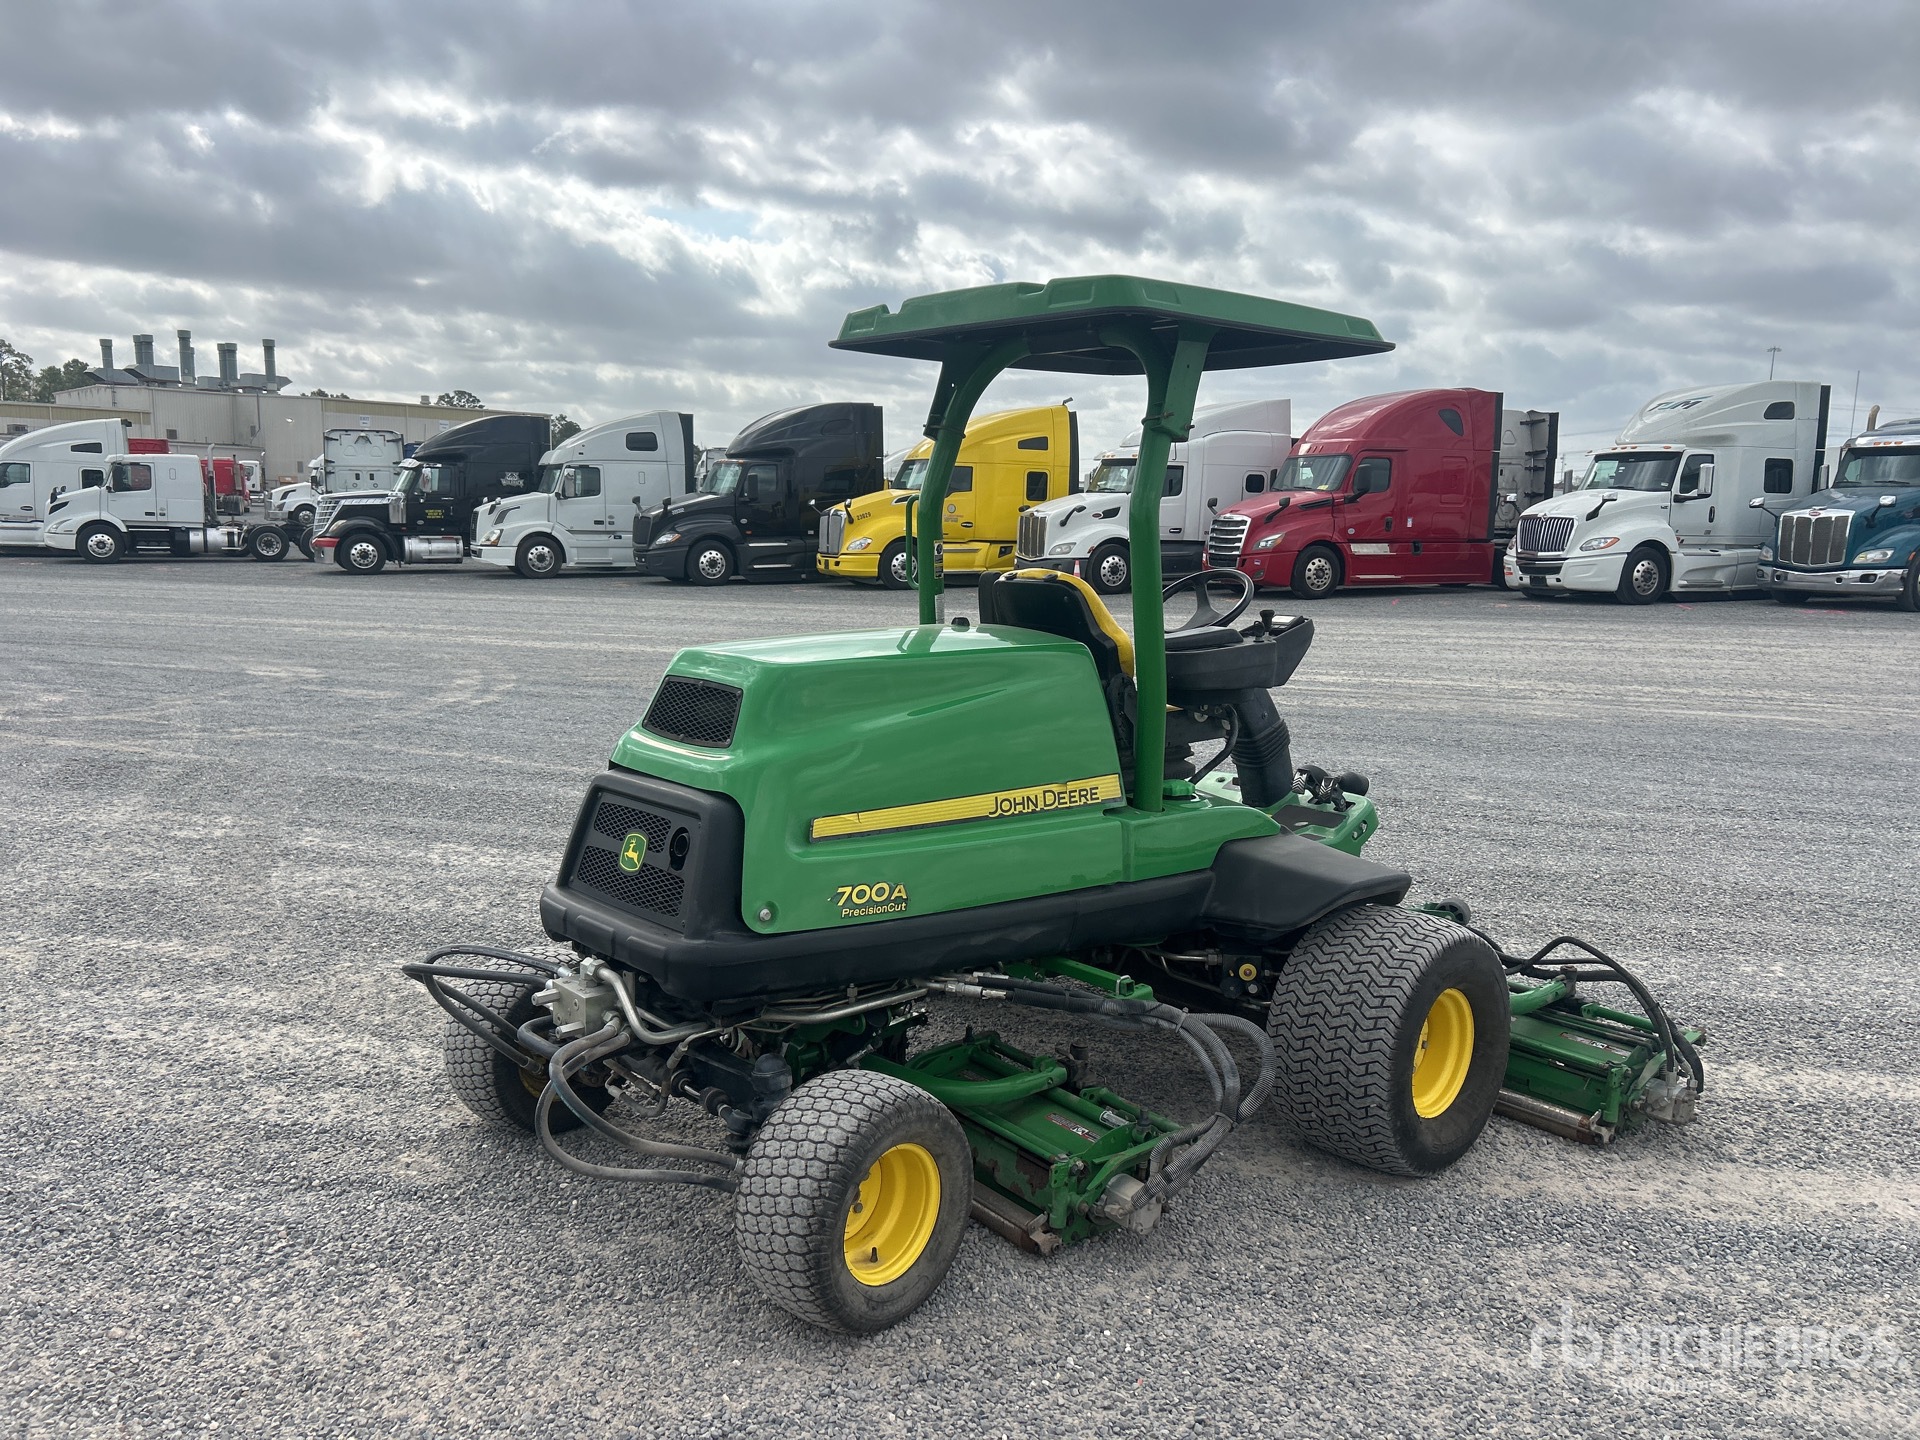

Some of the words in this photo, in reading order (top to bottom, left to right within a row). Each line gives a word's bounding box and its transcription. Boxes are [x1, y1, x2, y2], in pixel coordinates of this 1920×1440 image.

[988, 794, 1039, 816] JOHN
[1043, 786, 1100, 808] DEERE
[841, 901, 907, 918] PrecisionCut
